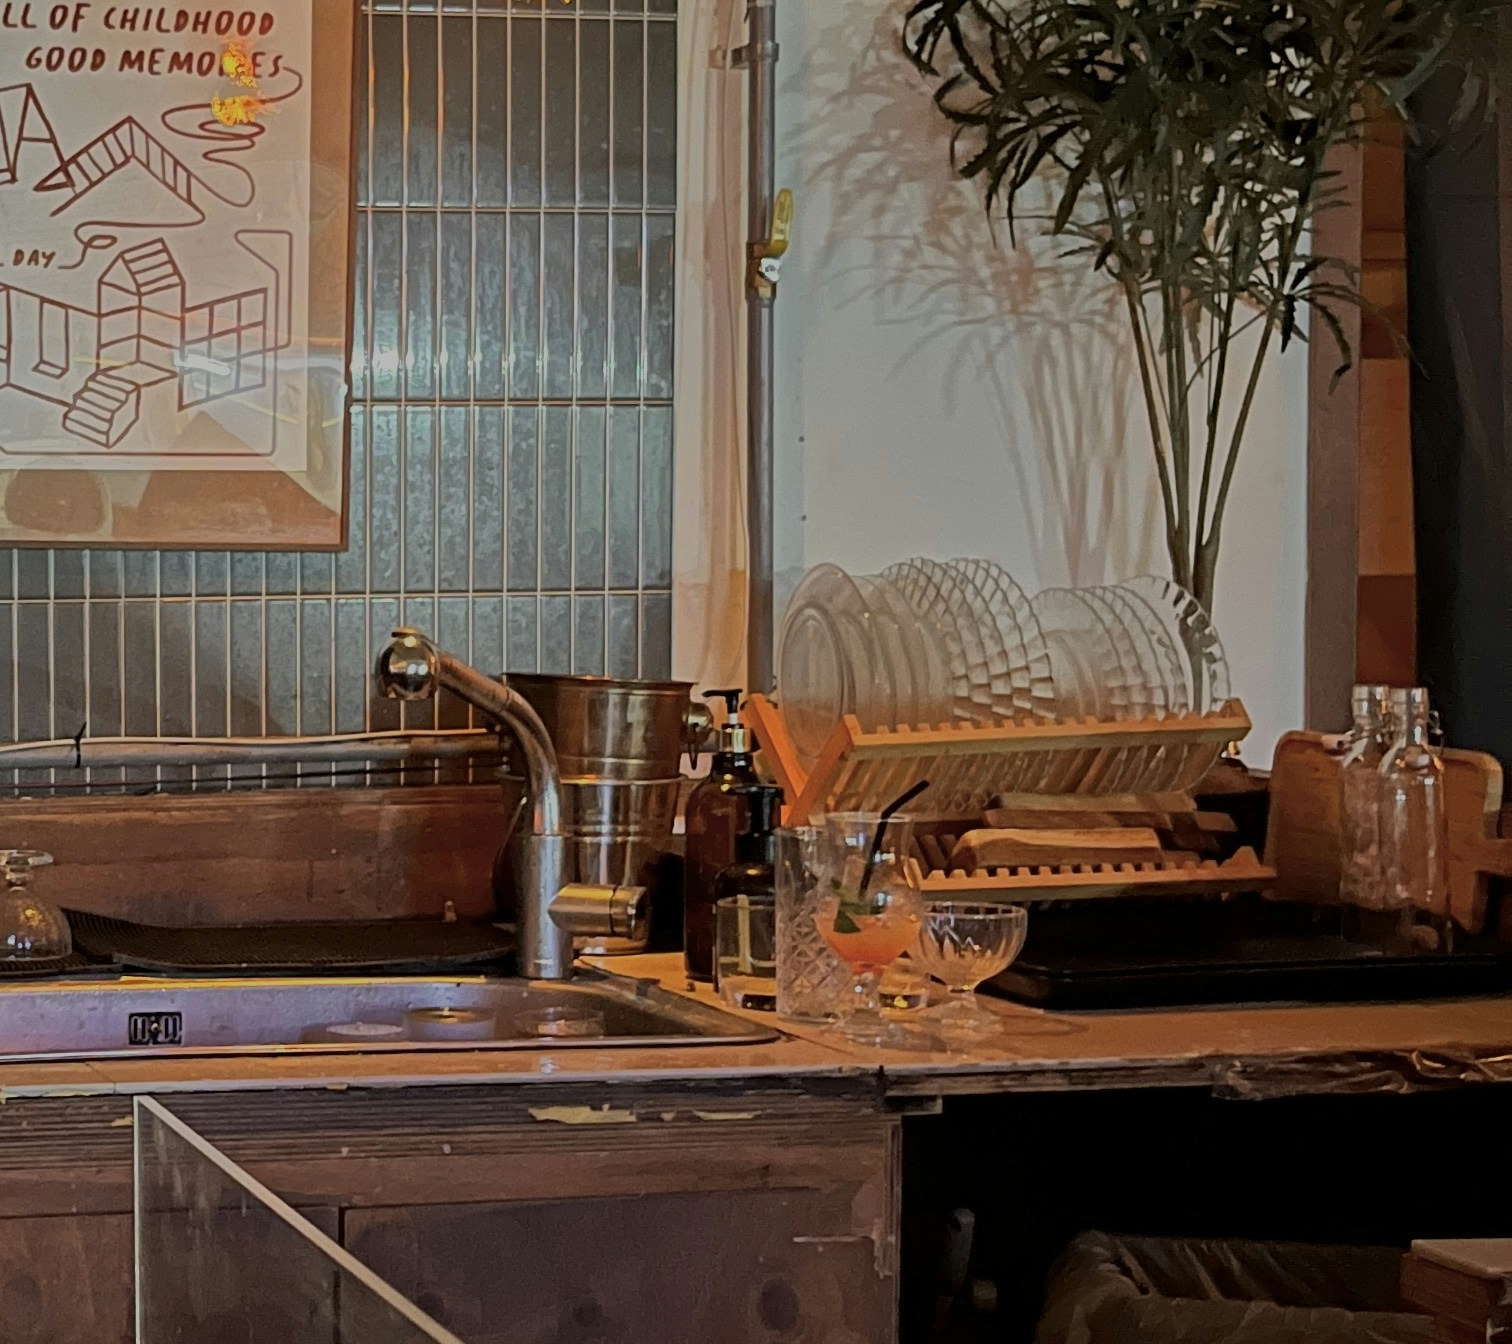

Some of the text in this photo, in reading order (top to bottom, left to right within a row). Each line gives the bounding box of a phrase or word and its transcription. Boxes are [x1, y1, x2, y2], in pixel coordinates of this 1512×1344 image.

[49, 2, 91, 33] OF
[103, 7, 275, 37] CHILDHOOD
[25, 45, 283, 78] GOOD MEMOES
[12, 248, 57, 269] DAY
